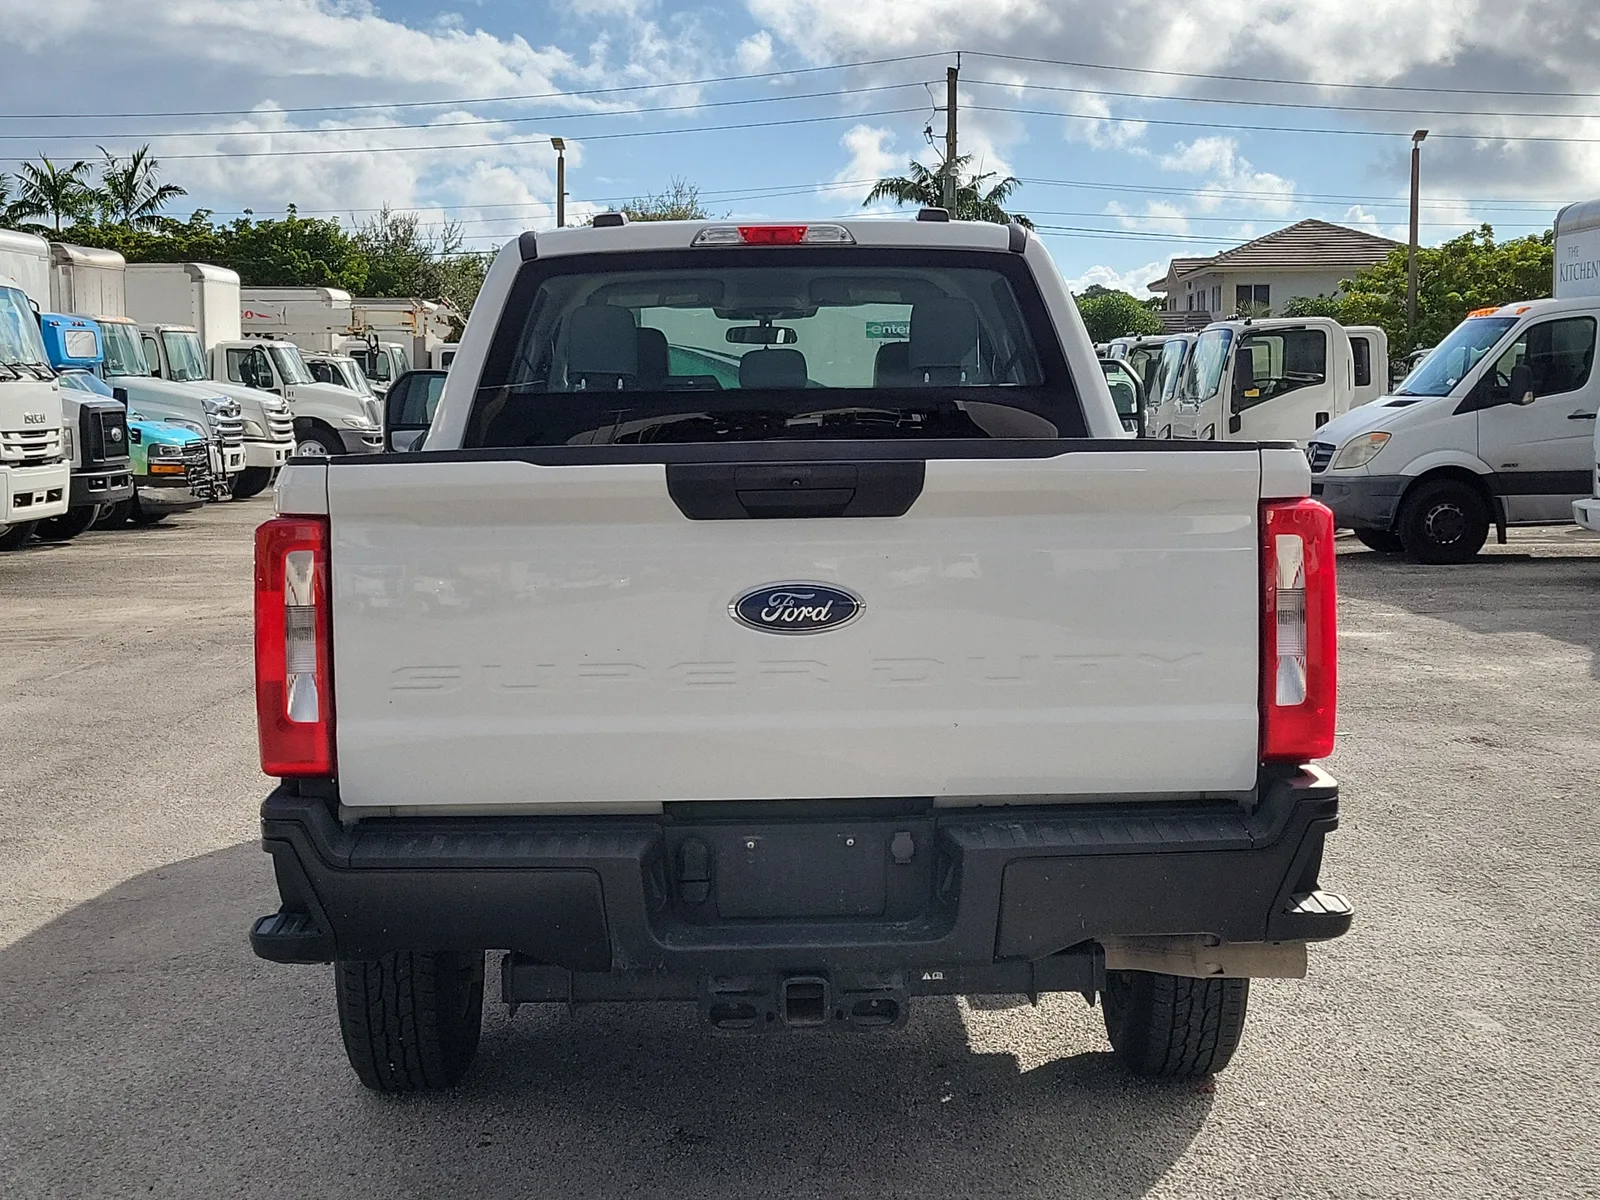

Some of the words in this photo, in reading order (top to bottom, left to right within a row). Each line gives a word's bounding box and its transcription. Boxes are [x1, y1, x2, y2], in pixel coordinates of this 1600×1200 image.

[761, 592, 834, 622] Ford
[390, 660, 830, 693] SUPER
[871, 653, 1203, 687] DUTY
